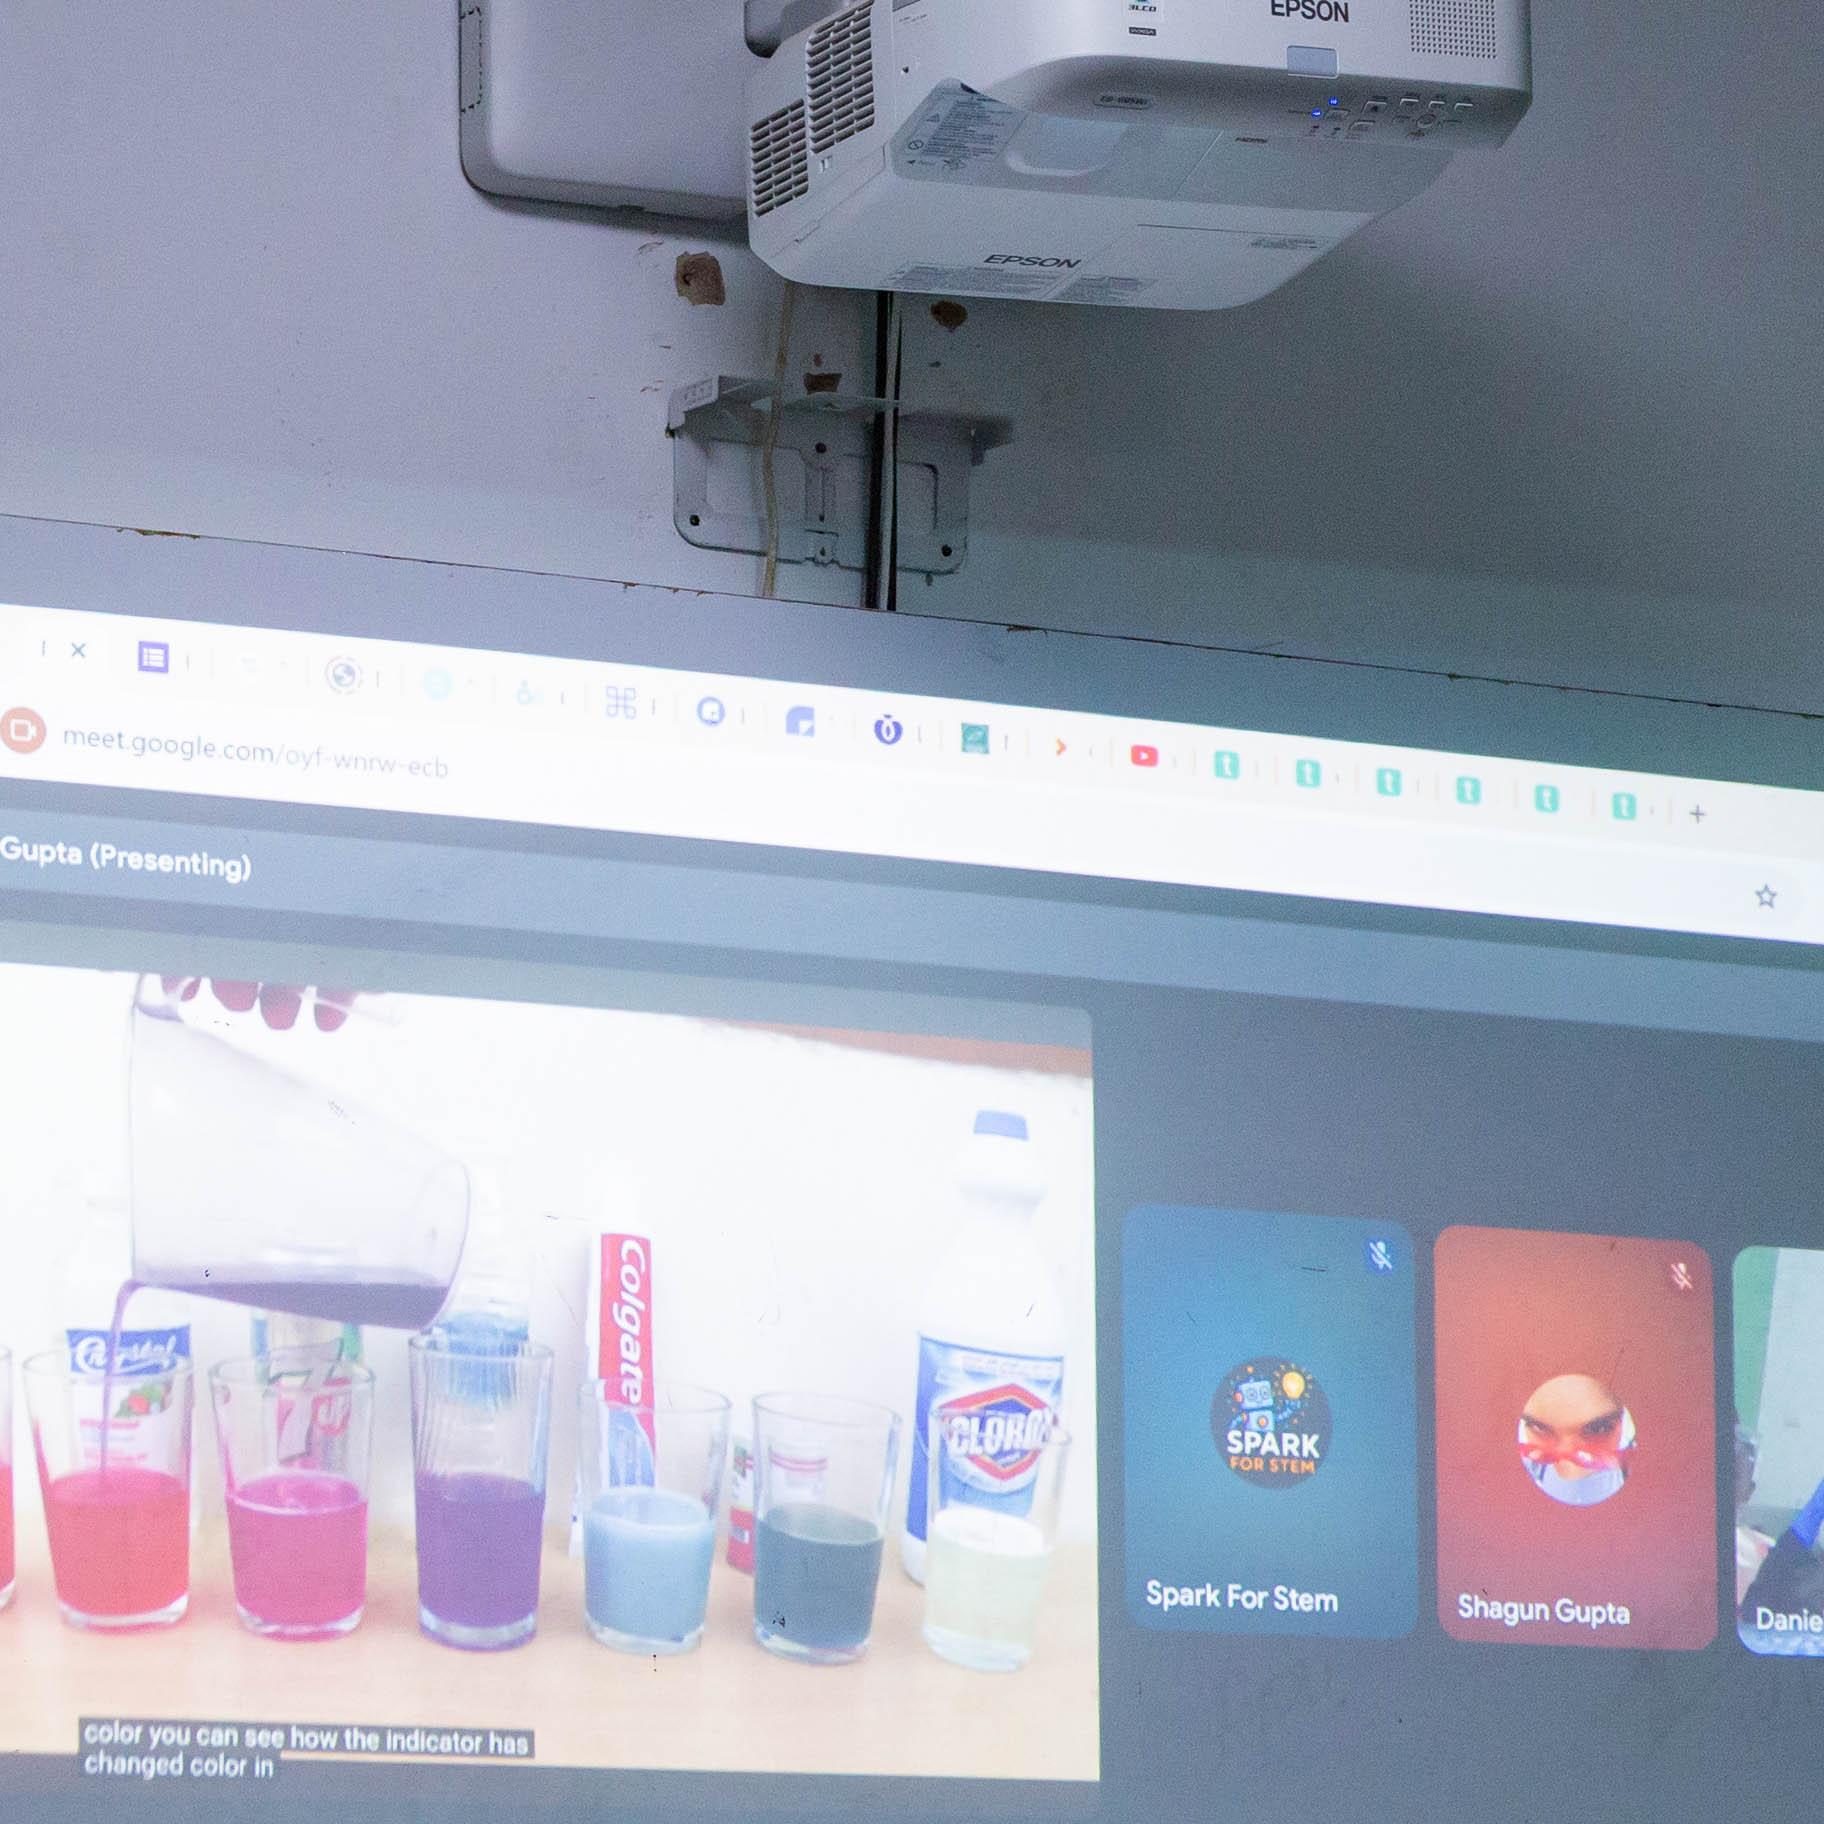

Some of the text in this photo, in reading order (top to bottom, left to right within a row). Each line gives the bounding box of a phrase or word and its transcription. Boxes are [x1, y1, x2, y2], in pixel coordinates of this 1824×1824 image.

[1271, 0, 1349, 22] EPSON
[983, 253, 1082, 269] EPSON
[0, 836, 82, 867] Gupta
[90, 842, 251, 883] (Presenting)
[612, 1239, 646, 1404] Colgate
[1227, 1430, 1320, 1458] SPARK
[1229, 1456, 1315, 1474] FOR STEM
[1146, 1579, 1338, 1612] Spark For Stem
[1458, 1594, 1630, 1629] Shagun Gupta
[84, 1721, 528, 1755] color you can see how the indicator has
[84, 1751, 274, 1781] changed color in
